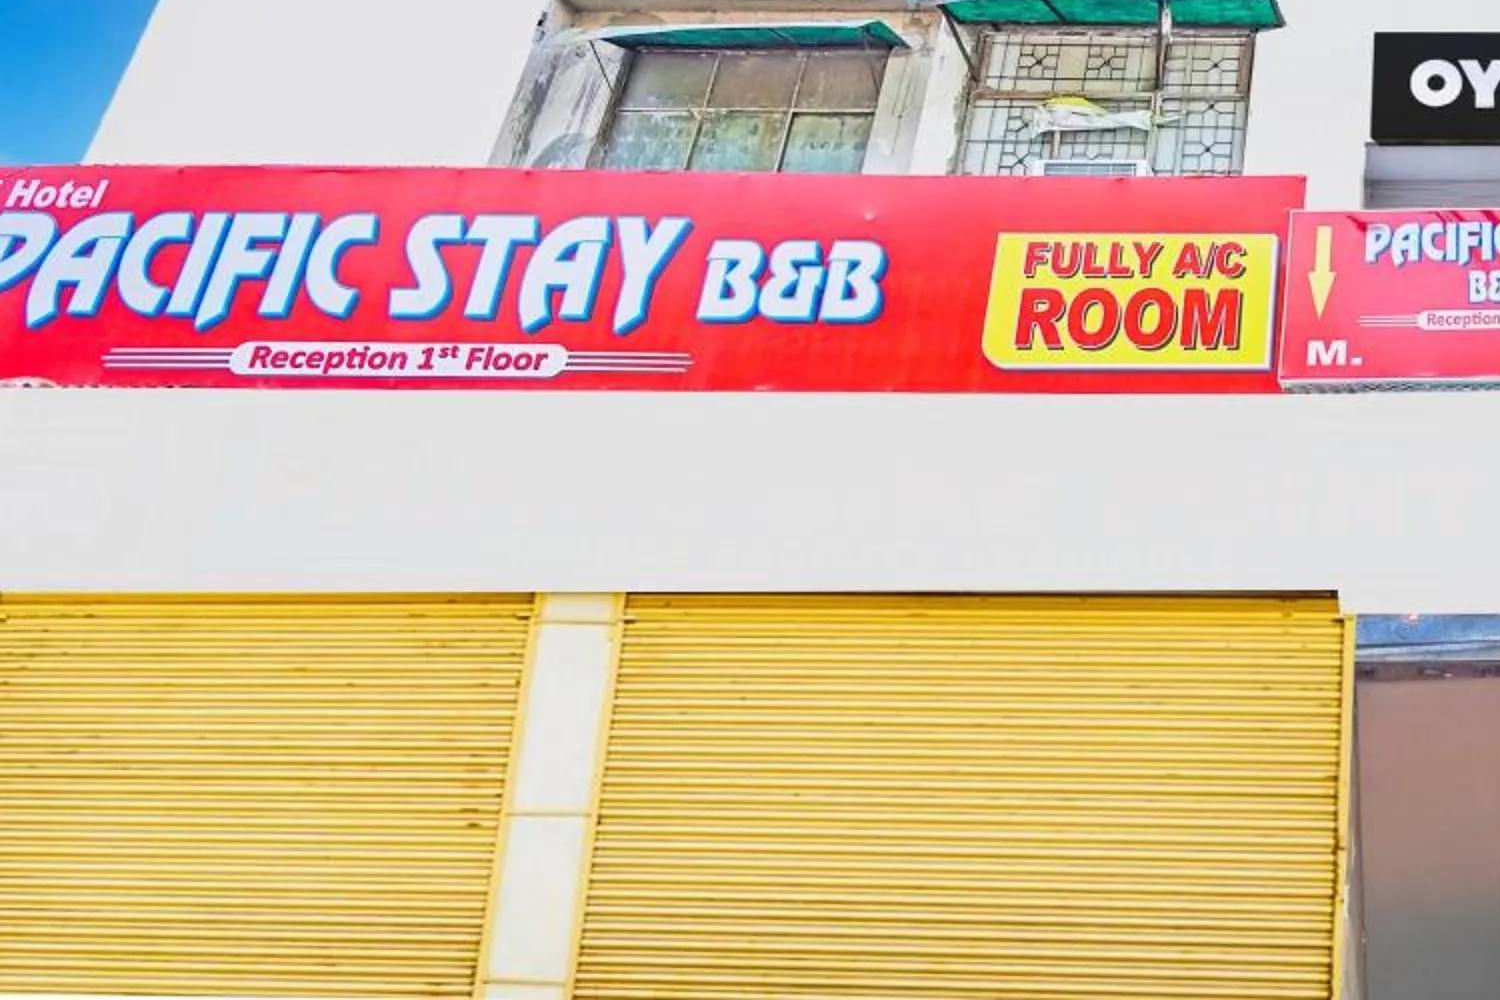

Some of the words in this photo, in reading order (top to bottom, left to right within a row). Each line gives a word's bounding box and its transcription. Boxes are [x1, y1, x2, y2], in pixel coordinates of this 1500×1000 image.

[5, 179, 109, 208] Hotel
[388, 214, 694, 336] STAY
[695, 239, 888, 325] B&B
[1022, 241, 1164, 279] FULLY
[1172, 241, 1248, 279] A/C
[1014, 287, 1243, 352] ROOM
[1427, 311, 1500, 328] Reception
[247, 344, 408, 375] Reception
[418, 343, 461, 371] 1st
[464, 347, 549, 372] Floor
[1306, 339, 1364, 367] M.
